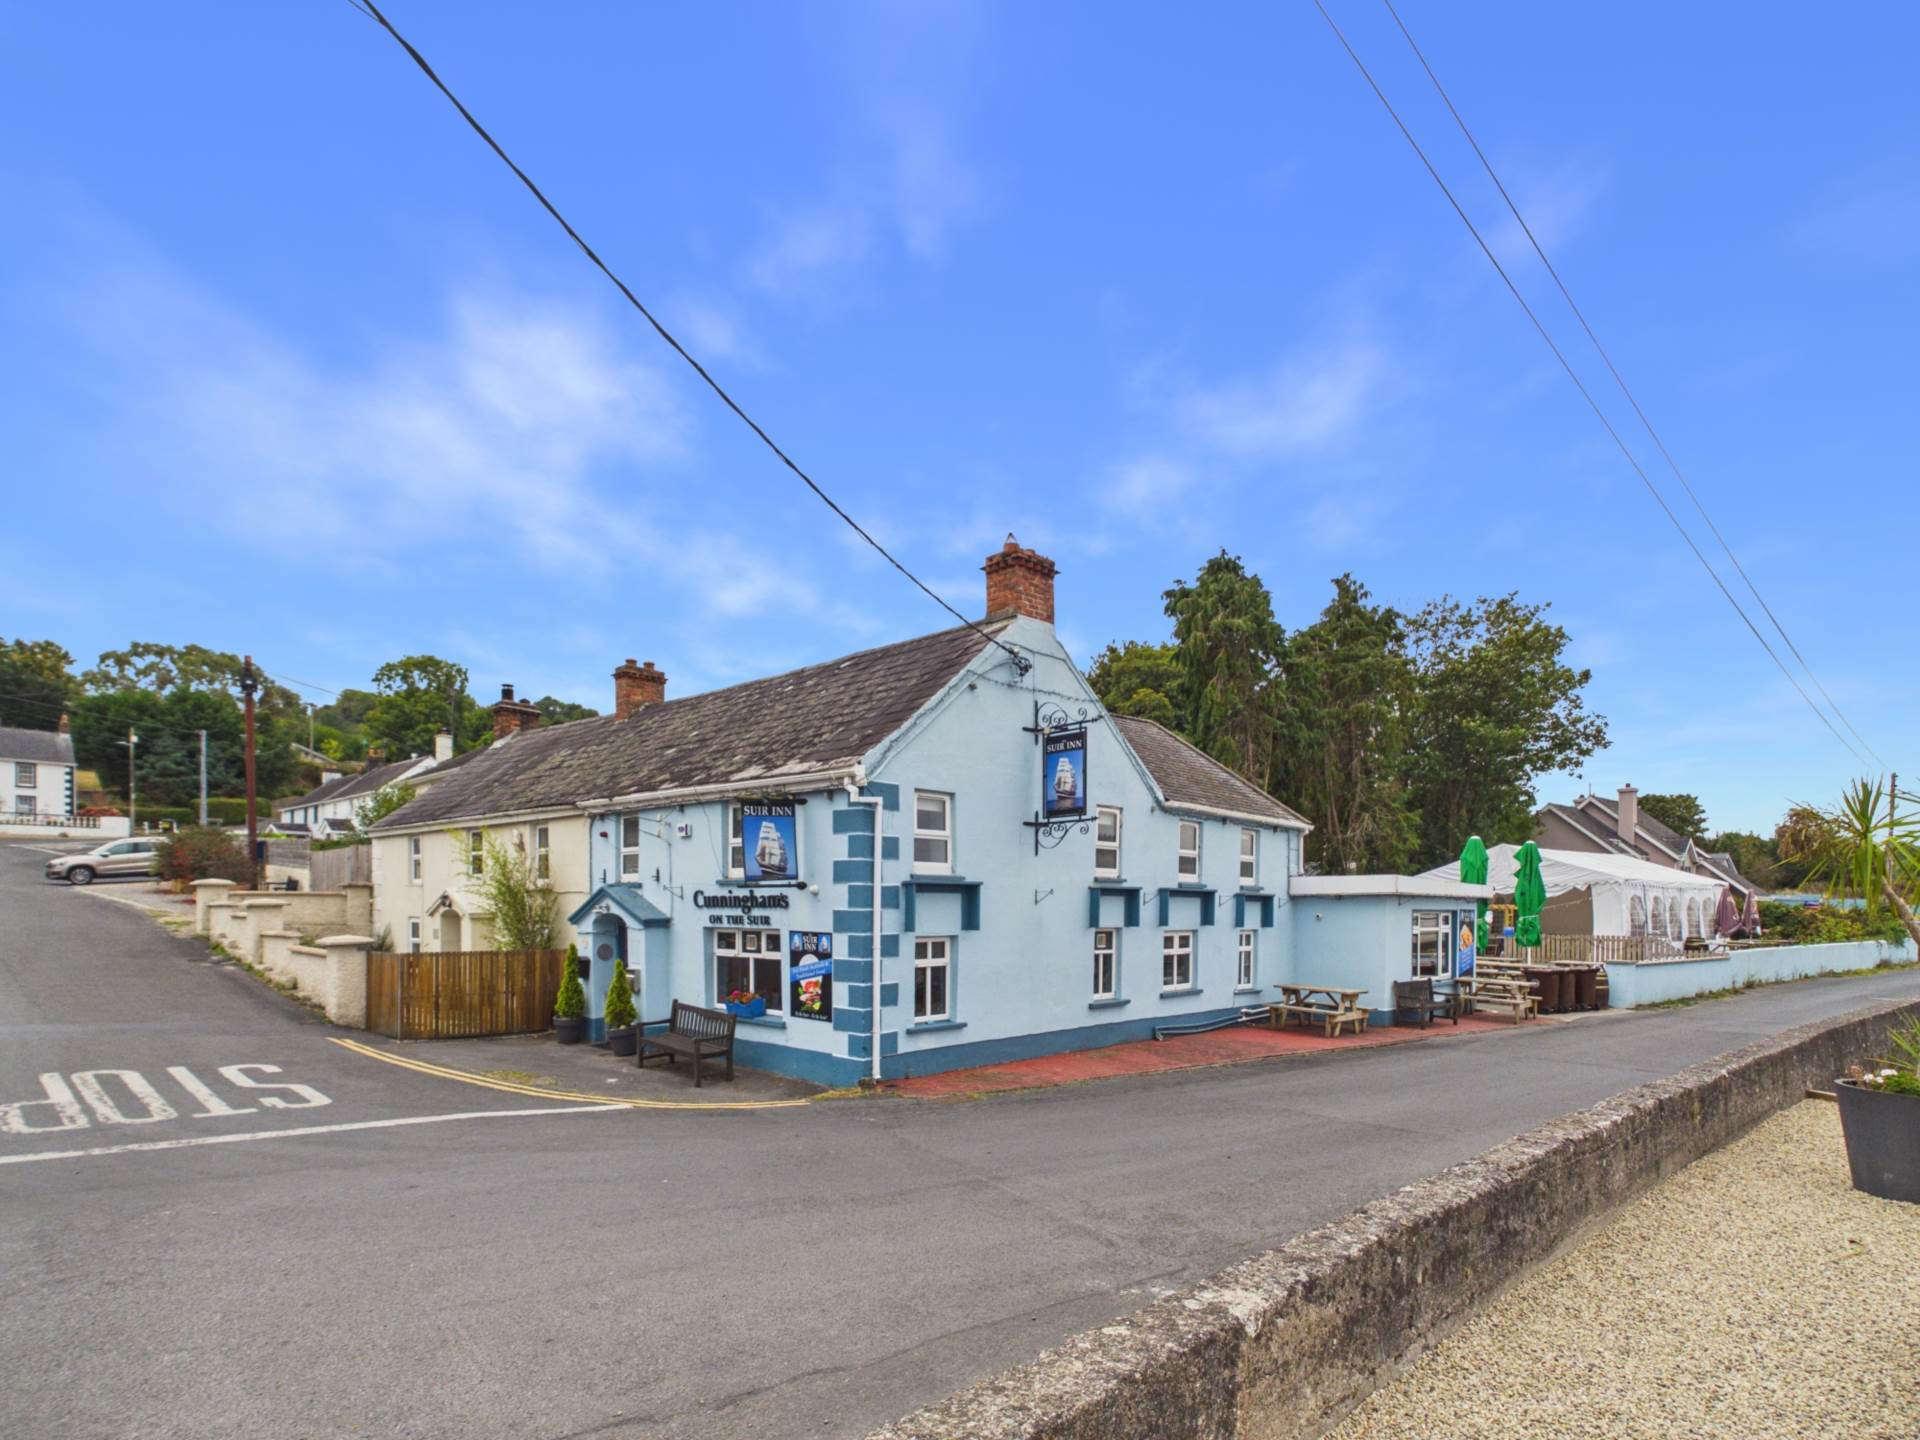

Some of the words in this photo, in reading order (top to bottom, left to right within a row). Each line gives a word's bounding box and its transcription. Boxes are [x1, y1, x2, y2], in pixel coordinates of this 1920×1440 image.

[1047, 742, 1065, 752] SUIR
[1066, 740, 1082, 749] INN
[743, 805, 769, 816] SUIR
[771, 806, 792, 817] INN
[693, 889, 790, 915] Cunningham's
[709, 914, 723, 924] ON
[725, 915, 745, 925] THE
[746, 915, 771, 926] SUIR
[802, 935, 818, 944] SUIR
[804, 943, 817, 952] INN
[0, 1064, 333, 1134] STOP
